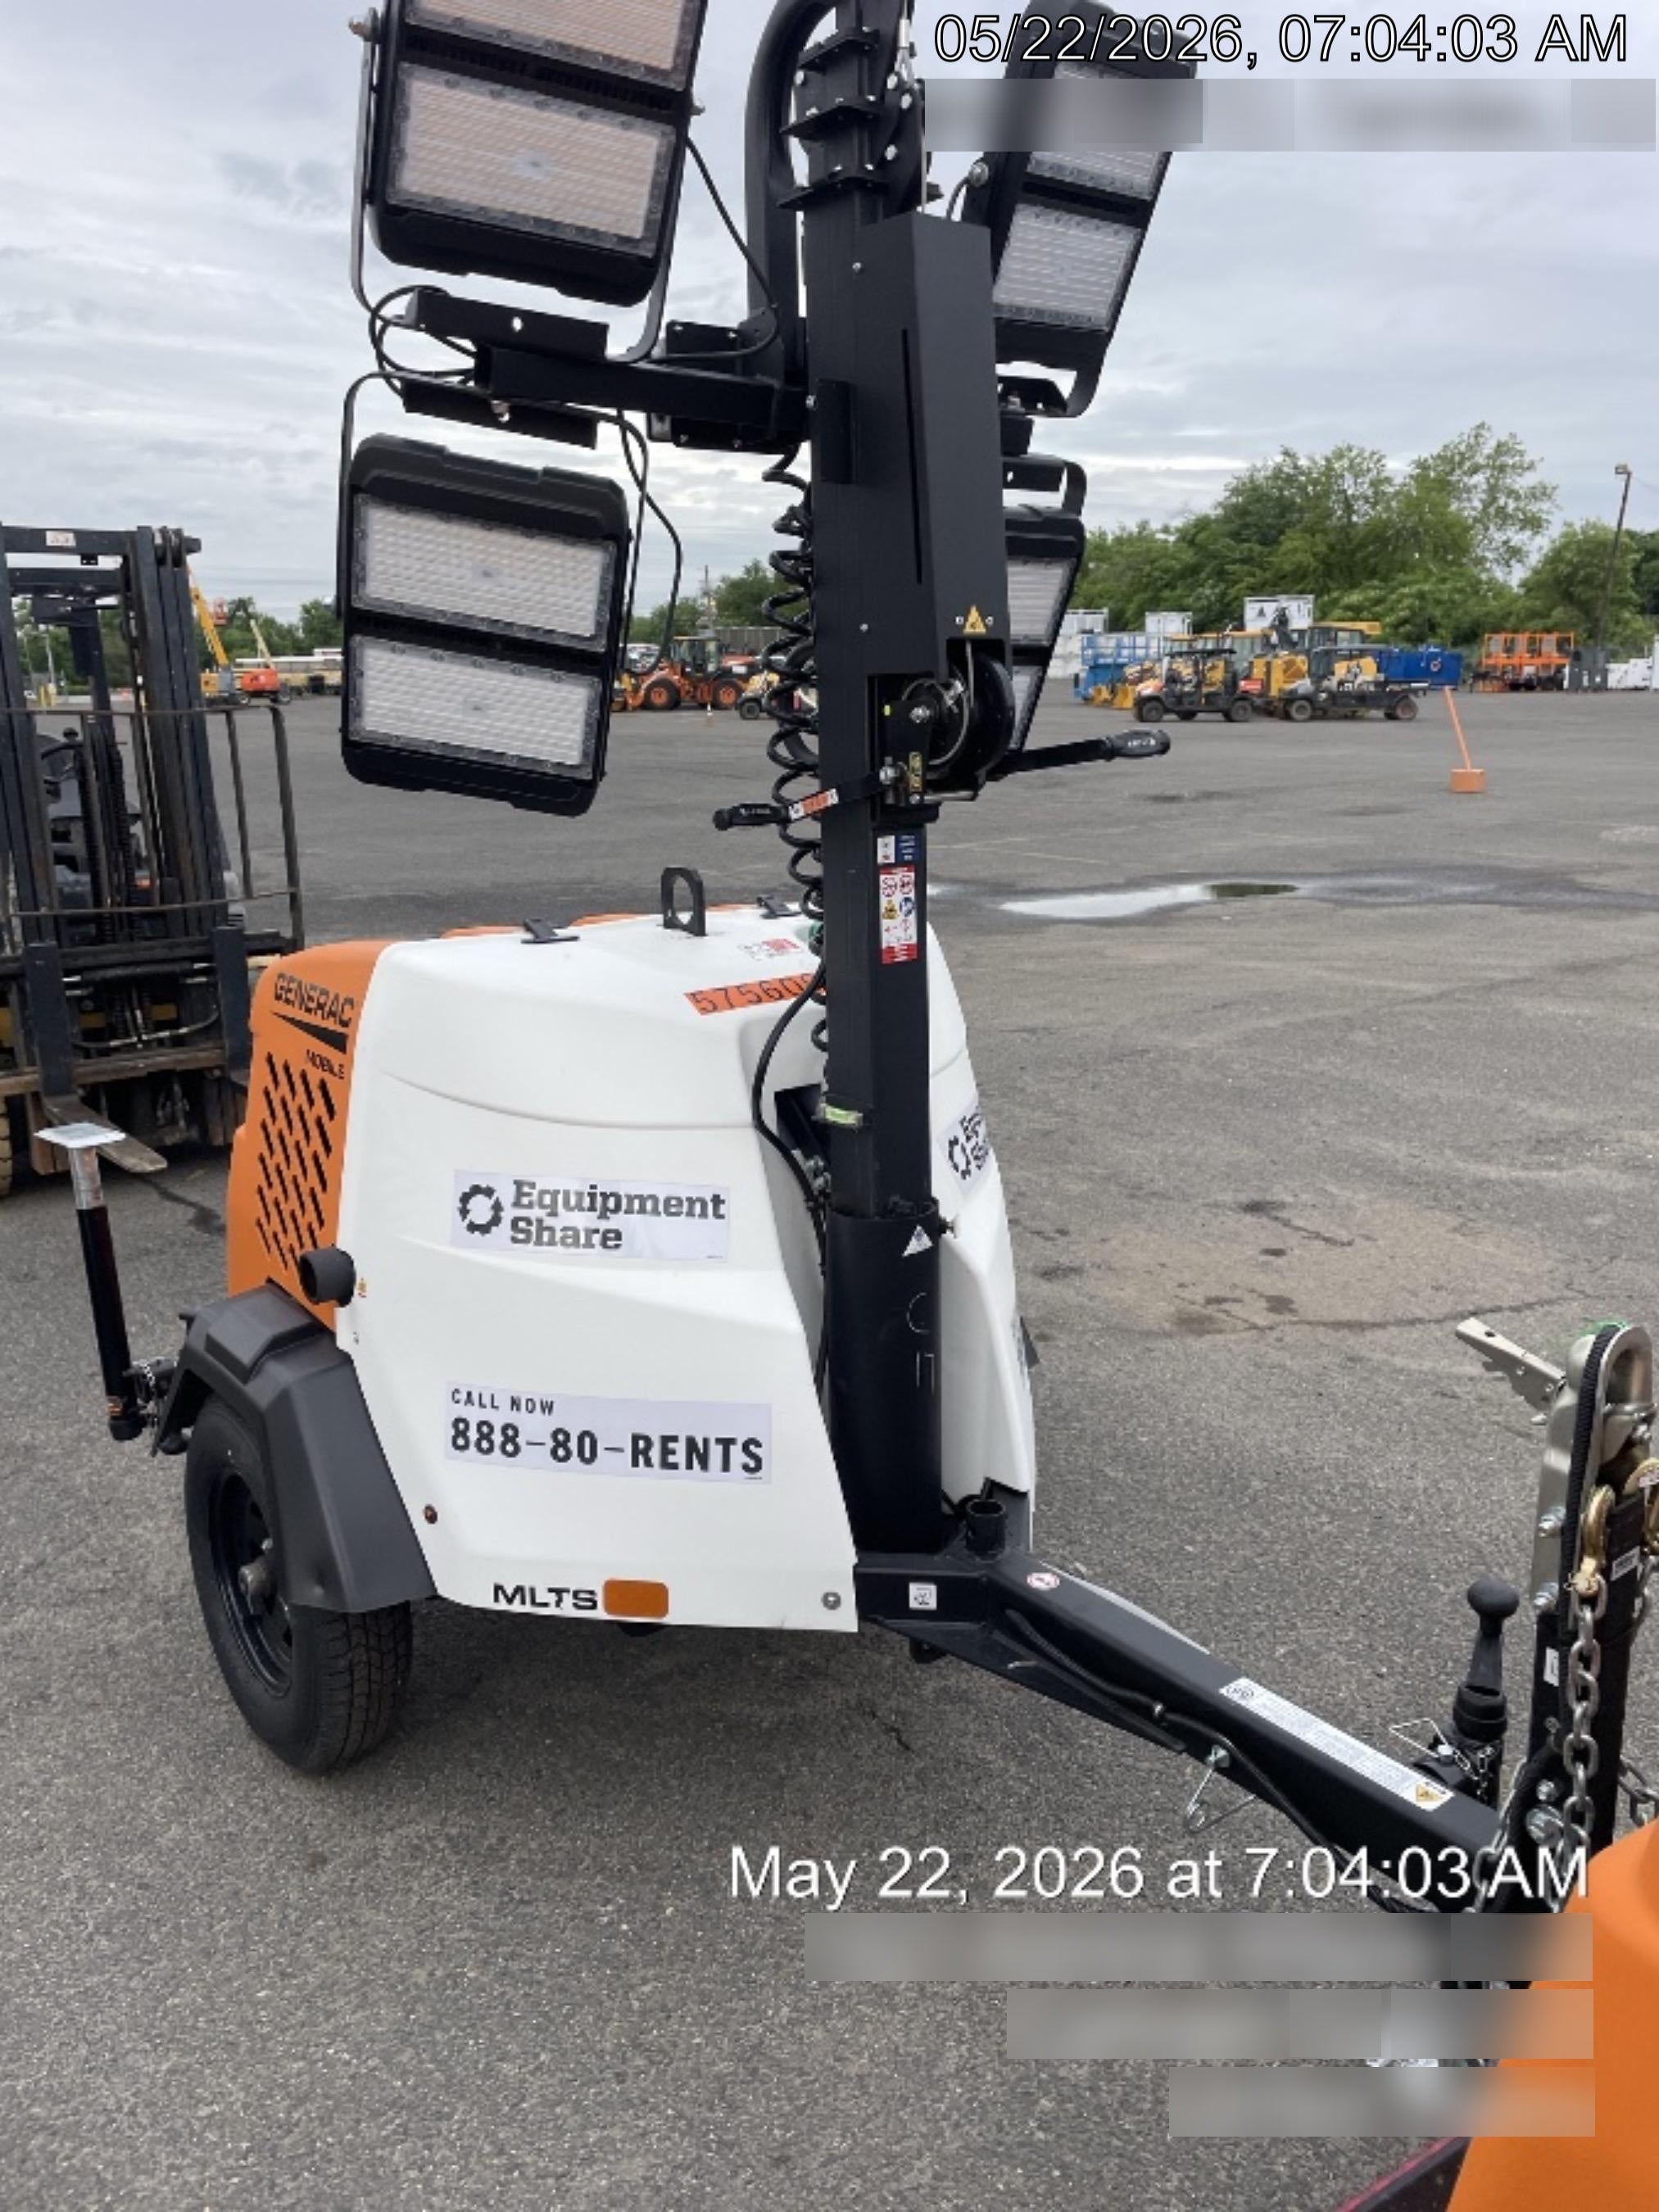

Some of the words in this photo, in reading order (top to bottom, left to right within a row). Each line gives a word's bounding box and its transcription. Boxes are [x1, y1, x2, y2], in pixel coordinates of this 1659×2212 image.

[274, 972, 355, 1028] GENERAC
[510, 1179, 727, 1220] Equipment
[510, 1216, 623, 1250] Share
[451, 1388, 501, 1411] CALL
[510, 1395, 555, 1416] NOW
[451, 1416, 764, 1475] 888-80-RENTS
[492, 1582, 599, 1611] MLTS
